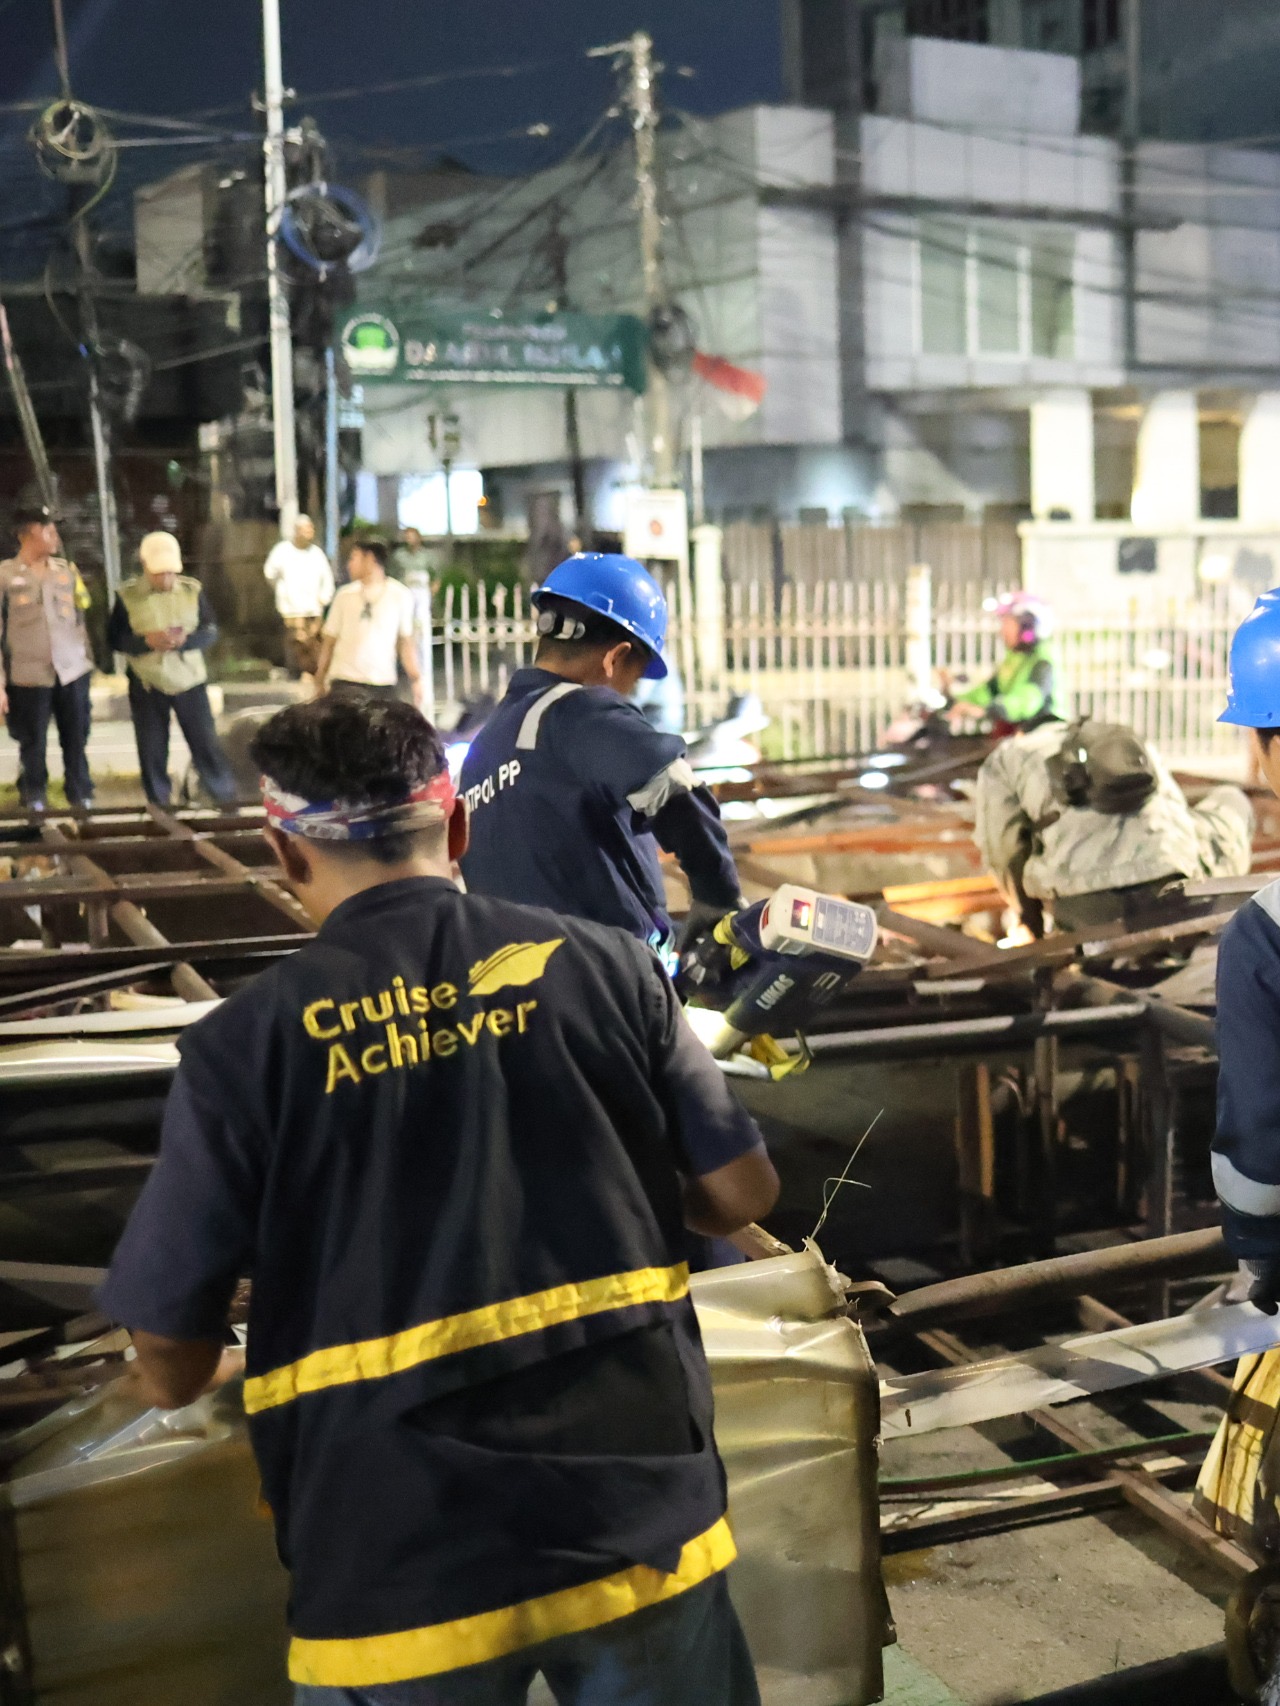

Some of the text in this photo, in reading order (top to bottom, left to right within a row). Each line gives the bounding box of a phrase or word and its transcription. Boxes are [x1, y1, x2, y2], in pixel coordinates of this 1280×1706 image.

[498, 759, 522, 791] PP
[302, 975, 459, 1040] Cruise
[755, 973, 795, 1011] LUKAS
[325, 1000, 537, 1094] Achiever
